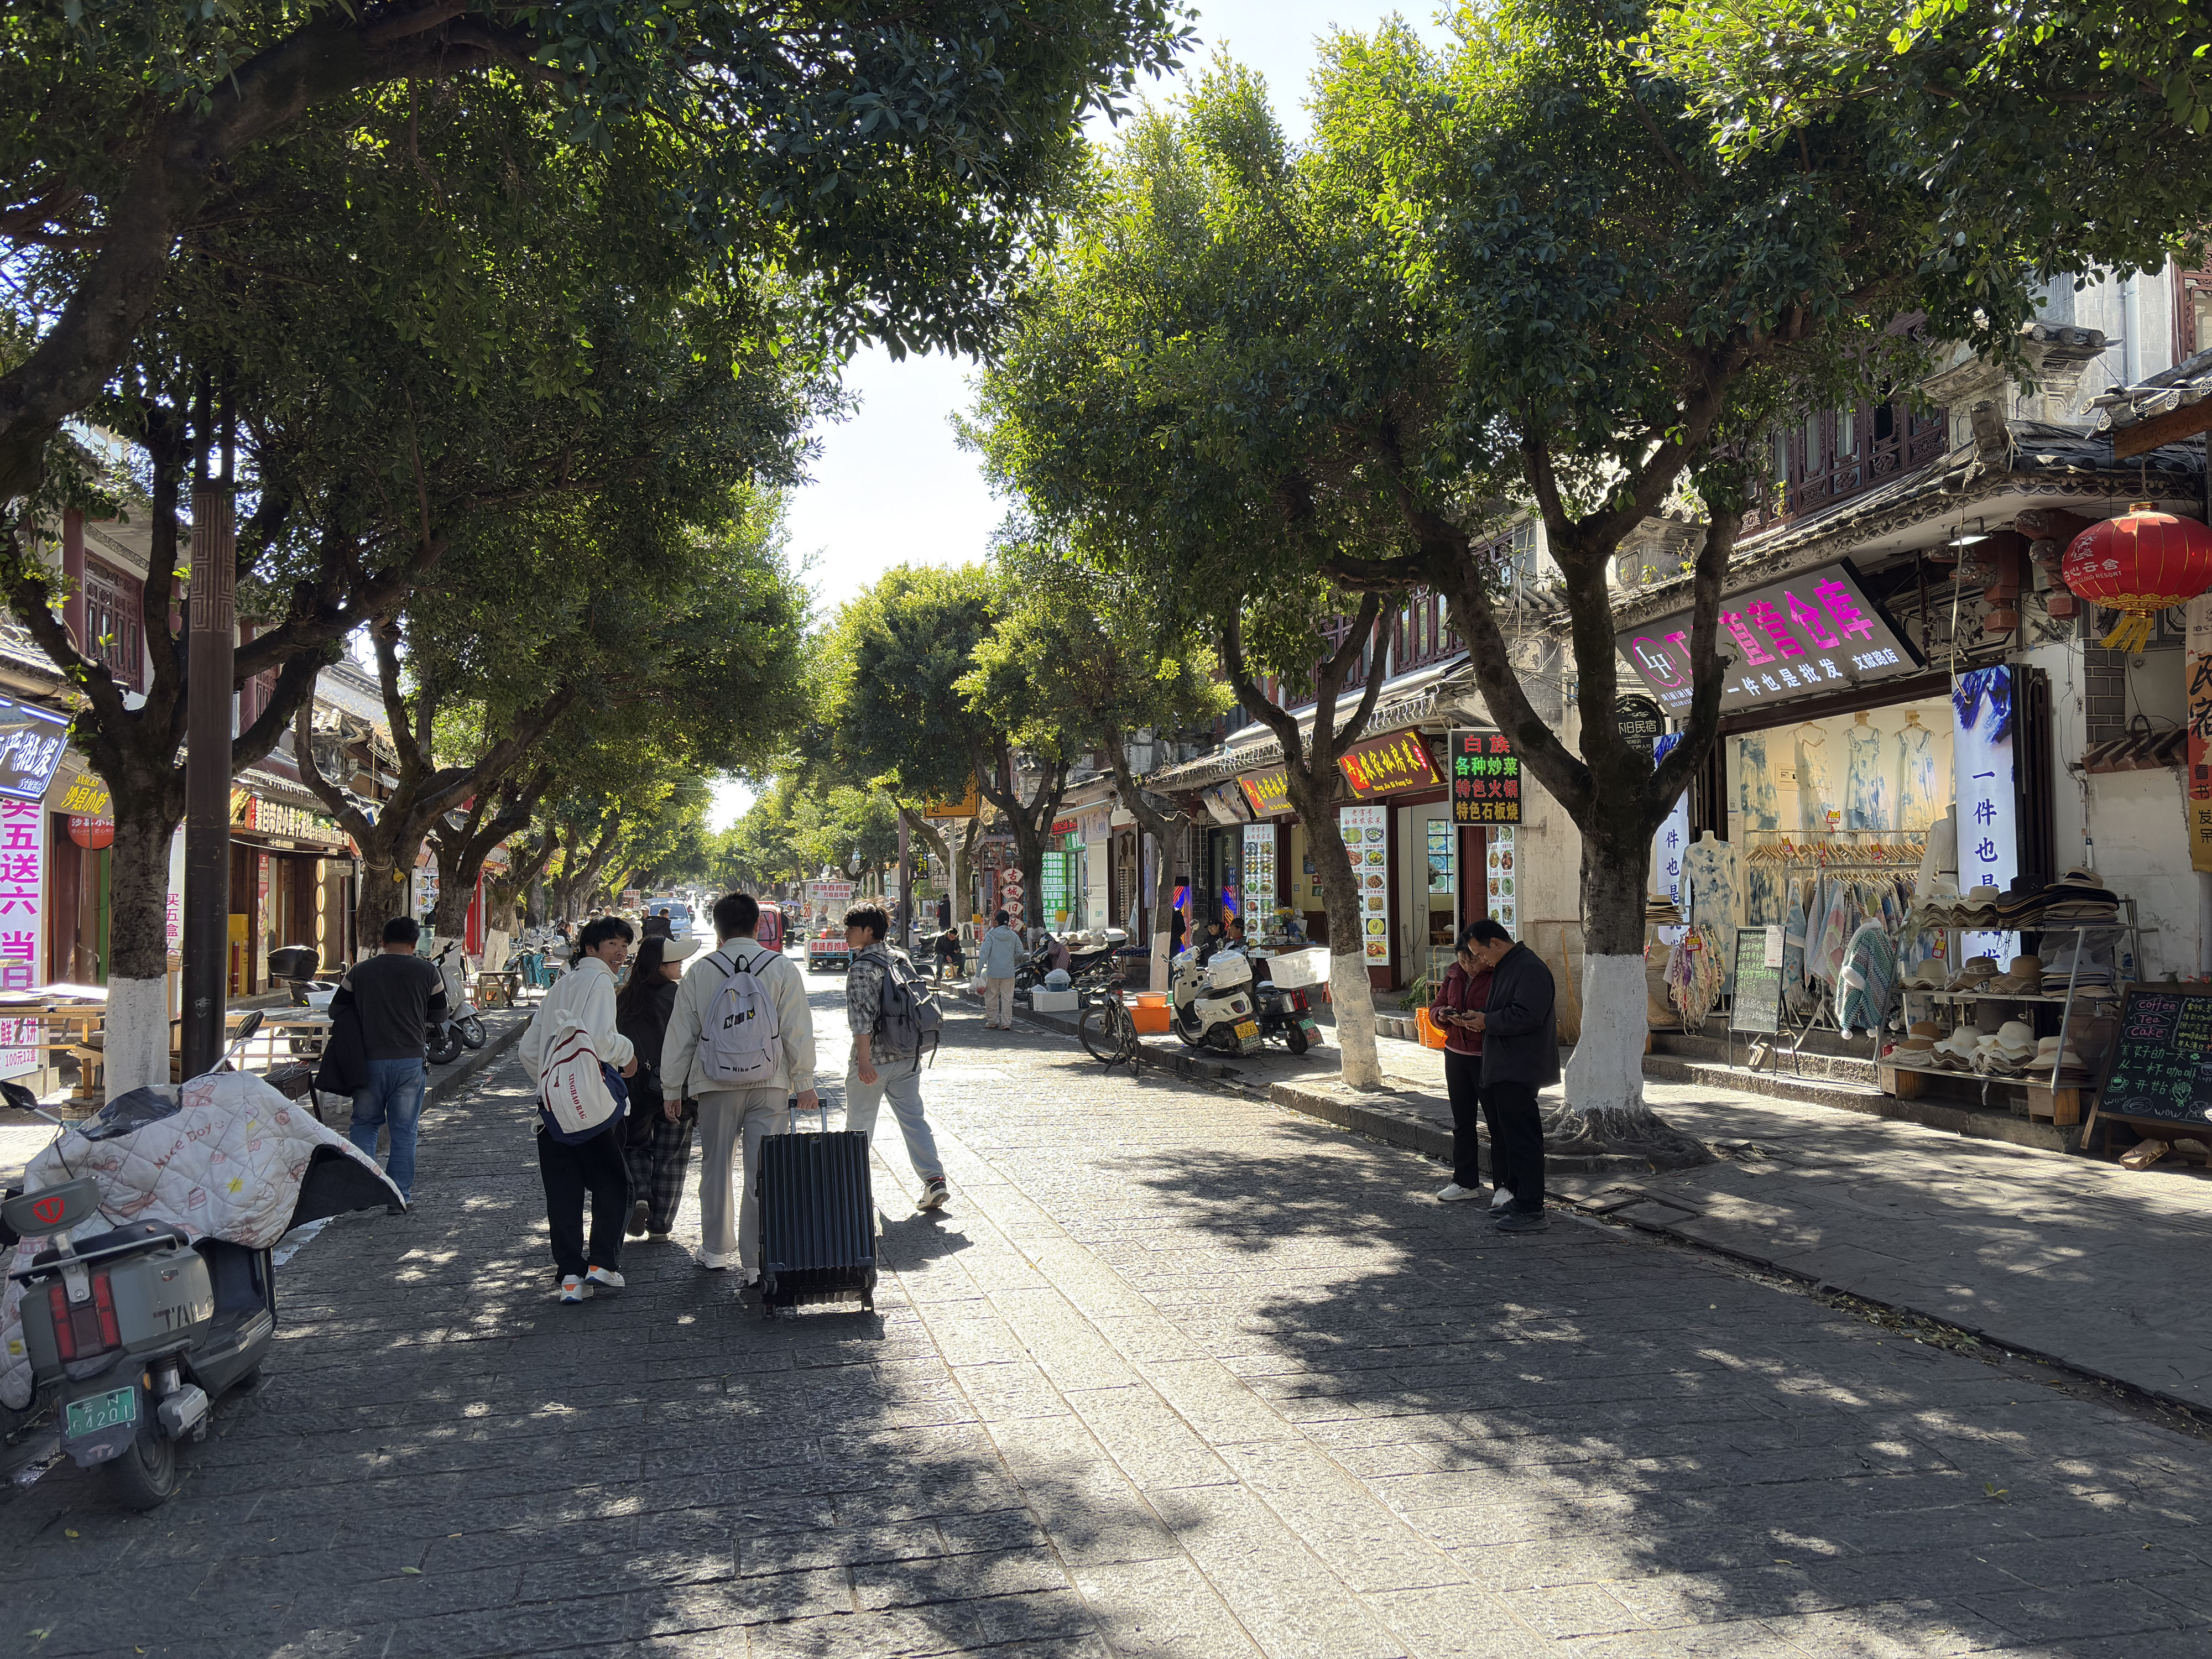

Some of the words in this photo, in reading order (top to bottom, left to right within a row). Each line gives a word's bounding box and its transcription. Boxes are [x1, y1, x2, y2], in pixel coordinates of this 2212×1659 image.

[1851, 646, 1899, 671] 文献路店
[1726, 658, 1843, 697] 一件也是批发
[1464, 734, 1510, 754] 白族
[1359, 739, 1421, 781] 农家私房菜
[1455, 756, 1518, 776] 各种炒菜
[75, 774, 98, 787] SNACKS
[1455, 779, 1519, 798] 特色火锅
[61, 785, 109, 815] 沙县小吃
[1344, 816, 1382, 825] 白族农家菜
[1456, 801, 1519, 821] 特色石板烧
[71, 818, 114, 827] 沙县小吃
[804, 906, 811, 917] 20
[2139, 999, 2176, 1012] coffee
[2139, 1015, 2161, 1024] Tea
[1237, 1029, 1258, 1039] 75R46
[6, 1048, 36, 1067] 100元12盒
[2121, 1043, 2186, 1061] 美好的一天
[2118, 1059, 2197, 1079] 从一杯咖啡
[569, 1073, 580, 1105] XINGHAO
[575, 1105, 587, 1120] BAG
[2135, 1079, 2169, 1095] 开始
[153, 1139, 185, 1170] Nice
[186, 1123, 212, 1142] Day
